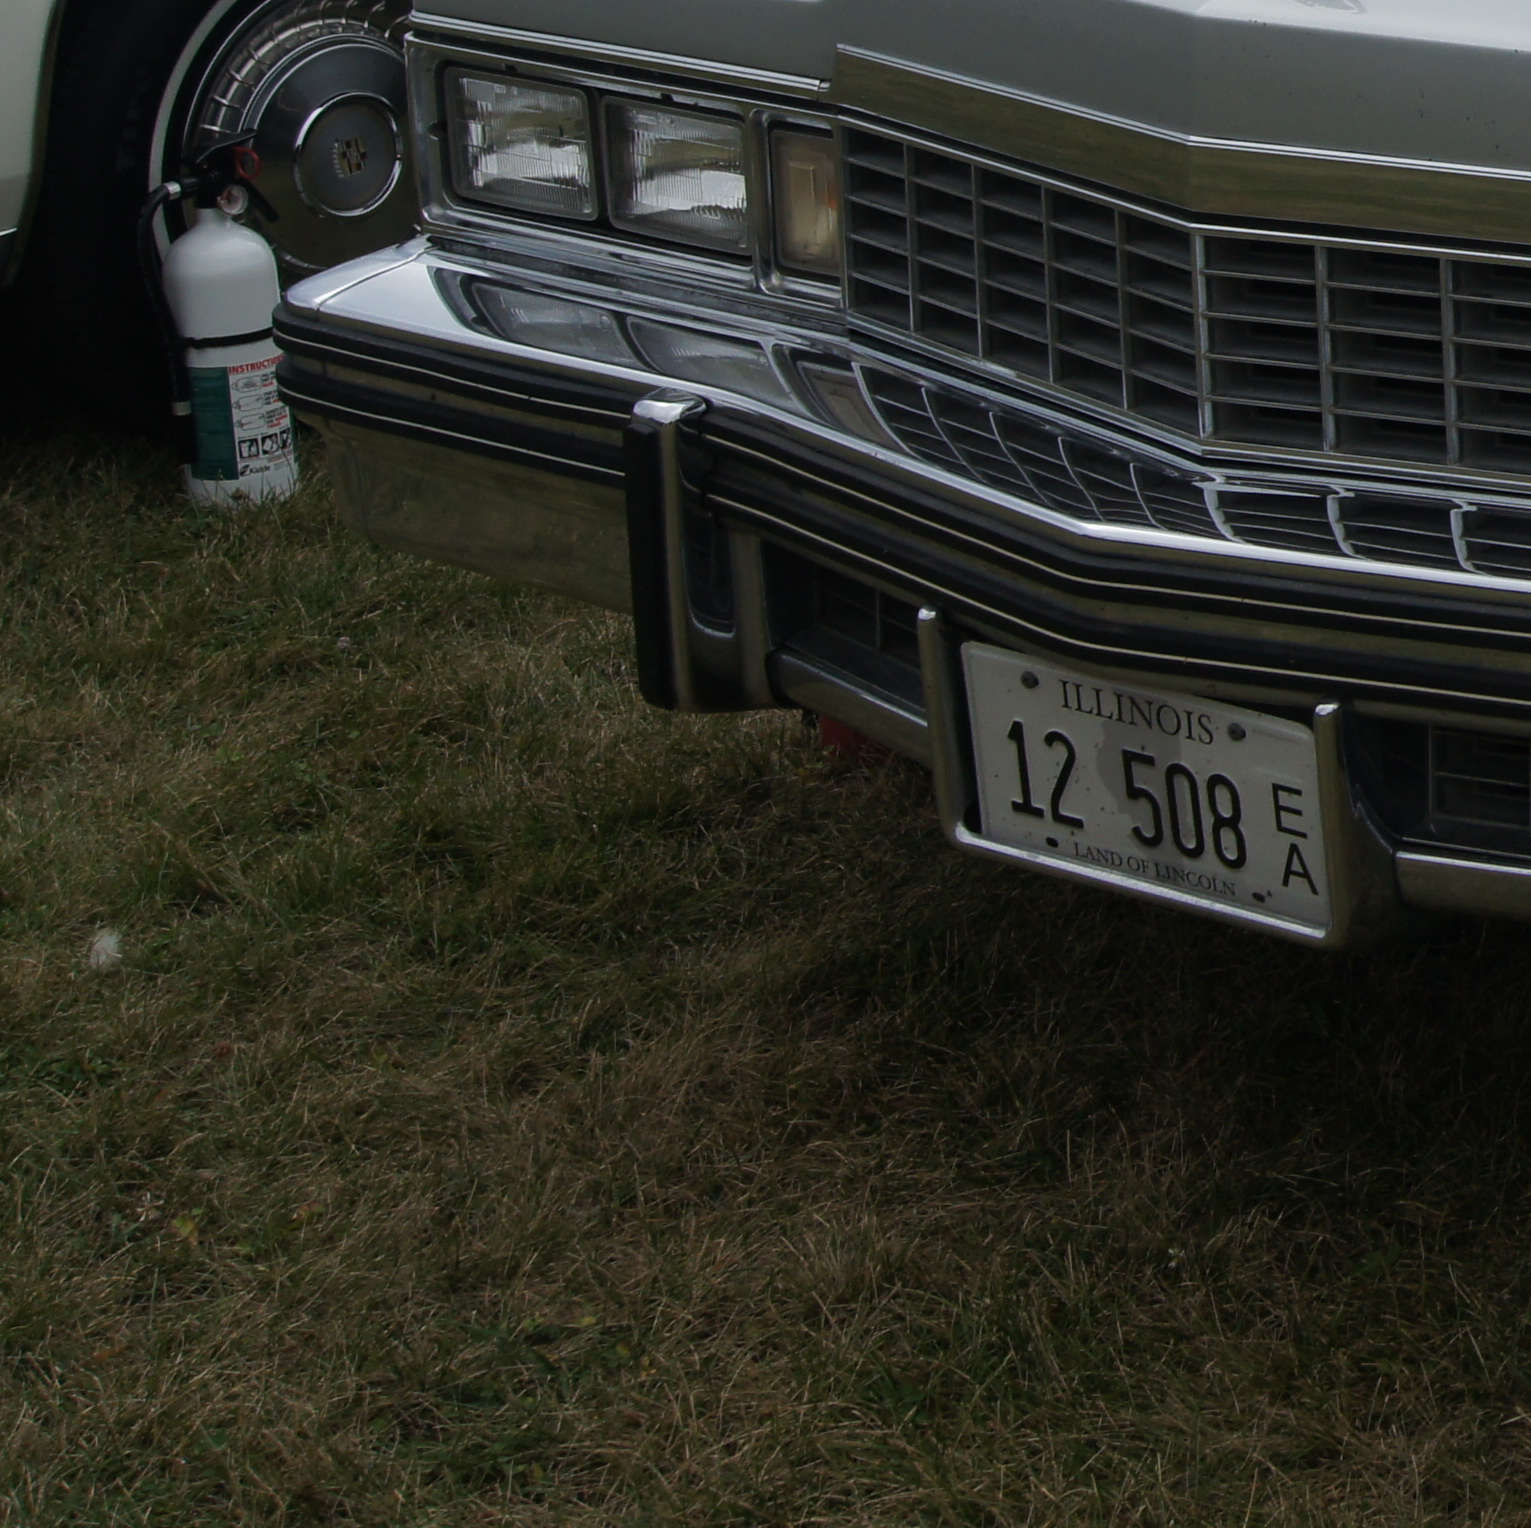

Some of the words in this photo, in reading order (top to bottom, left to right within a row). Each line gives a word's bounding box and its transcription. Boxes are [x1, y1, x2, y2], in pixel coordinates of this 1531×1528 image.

[1058, 678, 1214, 746] ILLINOIS
[1006, 718, 1085, 830] 12
[1121, 748, 1248, 871] 508
[1073, 841, 1123, 867] LAND
[1126, 855, 1151, 874] OF
[1154, 861, 1237, 897] LINCOLN
